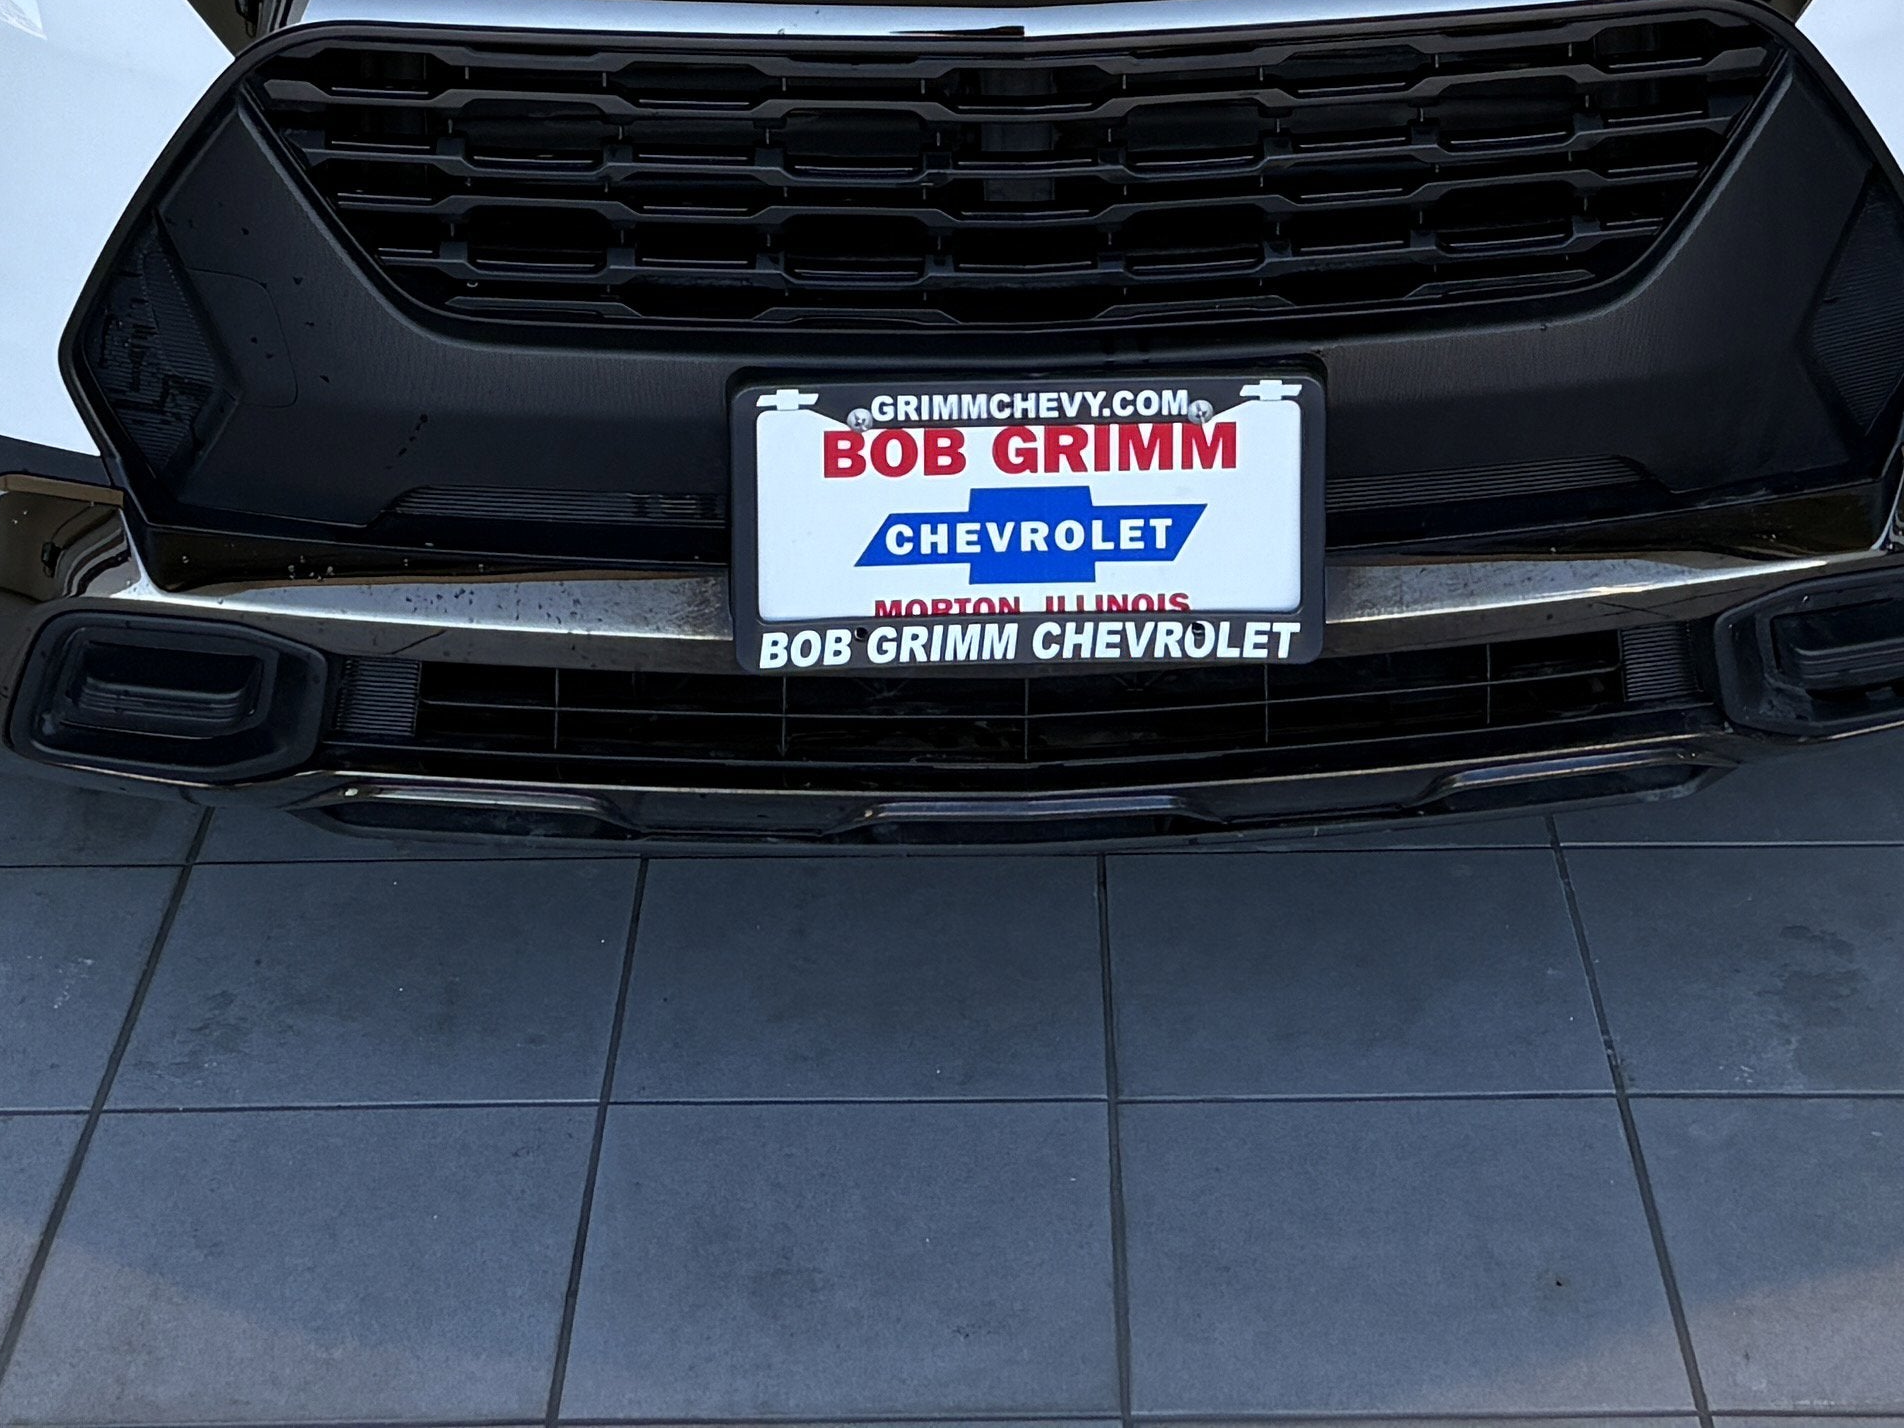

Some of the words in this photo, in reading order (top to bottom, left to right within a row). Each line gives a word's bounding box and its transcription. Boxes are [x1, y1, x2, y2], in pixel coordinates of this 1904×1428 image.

[870, 389, 1190, 424] GRIMMCHEVY.COM
[822, 427, 968, 479] BOB
[992, 421, 1238, 474] GRIMM
[884, 517, 1174, 555] CHEVROLET
[759, 628, 853, 669] BOB
[867, 624, 1017, 663] GRIMM
[1031, 620, 1302, 662] CHEVROLET
